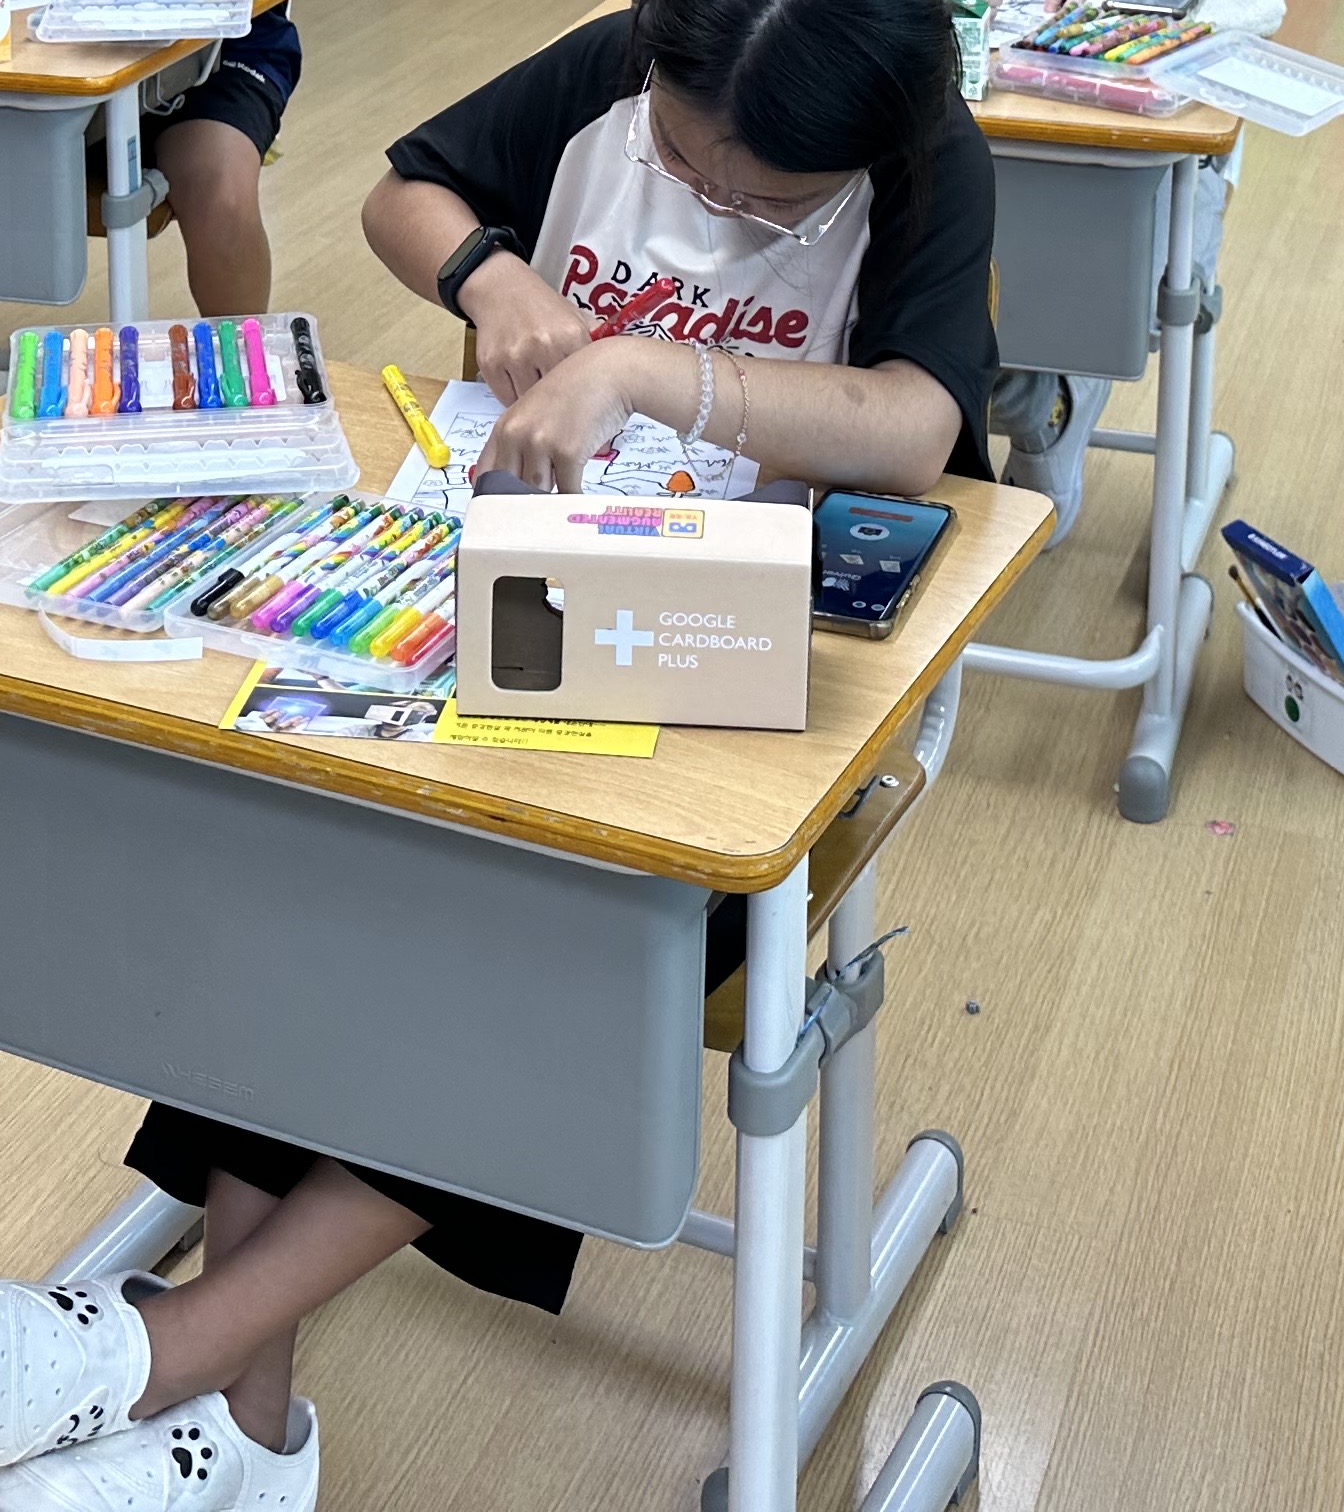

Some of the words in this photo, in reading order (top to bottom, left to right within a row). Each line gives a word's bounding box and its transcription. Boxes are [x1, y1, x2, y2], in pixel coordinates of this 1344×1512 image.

[610, 259, 711, 309] DARK
[561, 244, 809, 349] Paadise
[567, 513, 663, 527] AUGMENTED
[604, 506, 663, 518] REALITY
[597, 525, 659, 537] VIRTUAL
[659, 611, 737, 629] GOOGLE
[658, 633, 773, 652] CARDBOARD
[657, 653, 699, 669] PLUS
